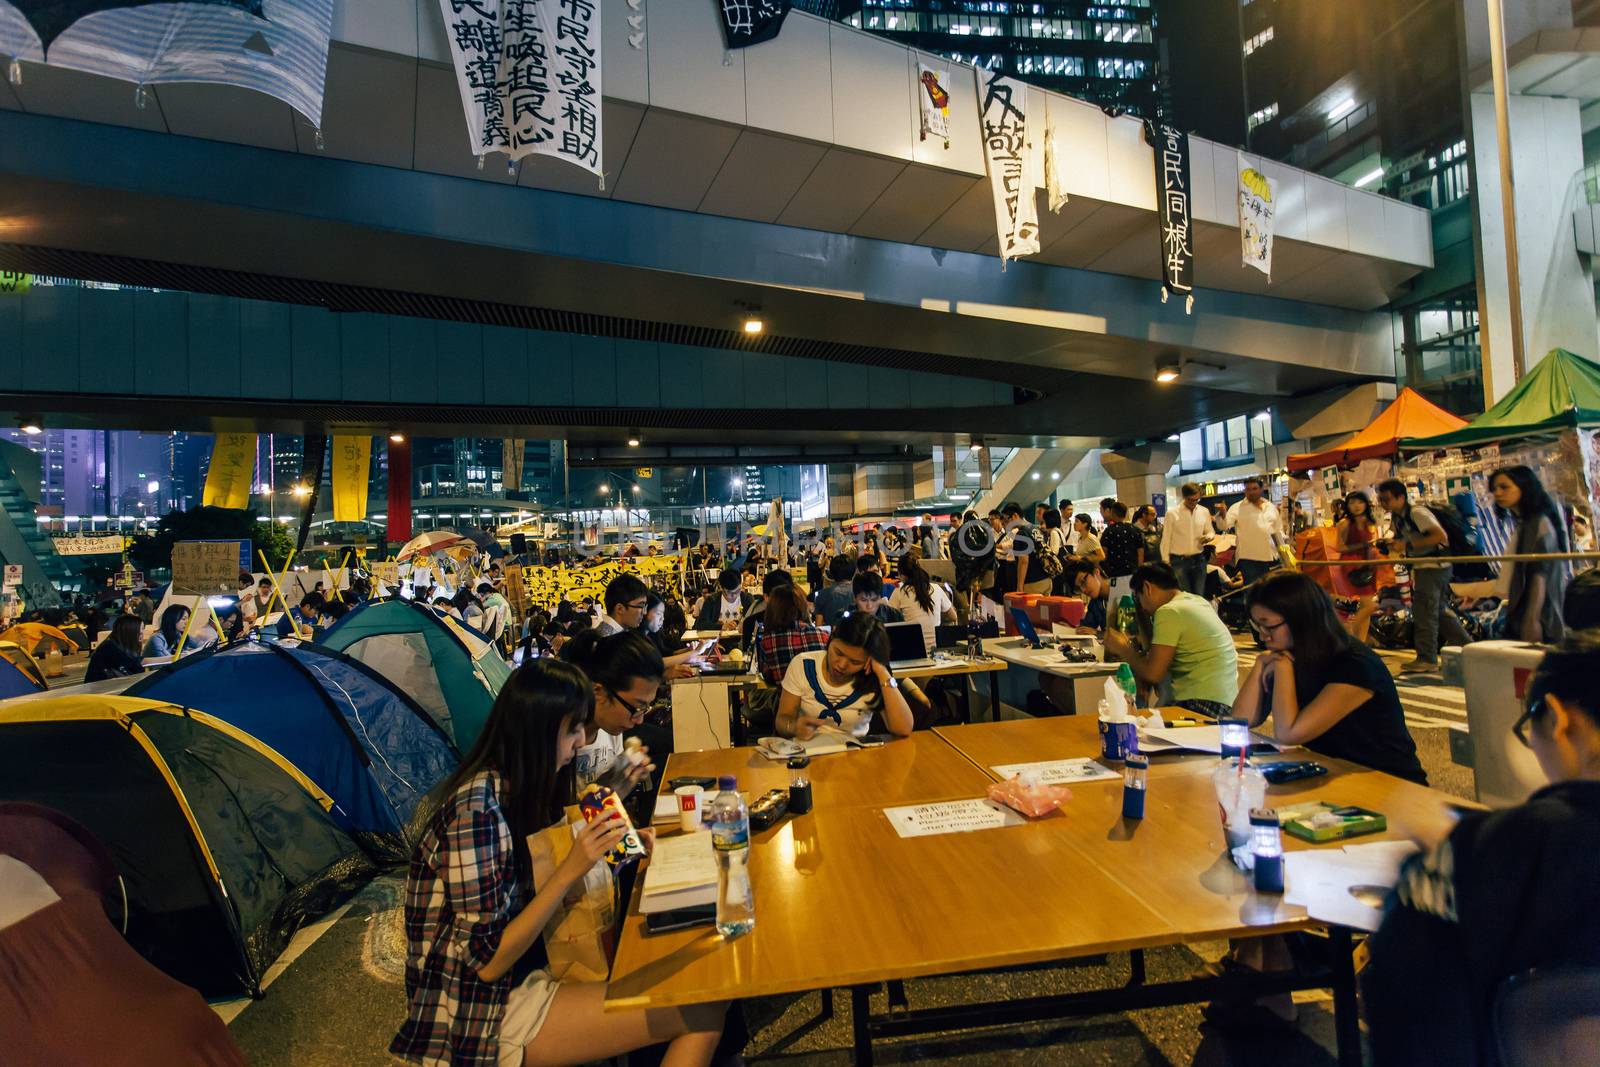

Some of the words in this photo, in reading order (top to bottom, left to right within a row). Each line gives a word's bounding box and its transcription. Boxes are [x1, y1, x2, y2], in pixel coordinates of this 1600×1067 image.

[503, 0, 555, 150] 生喚起民心
[555, 0, 598, 167] 市民守望相助
